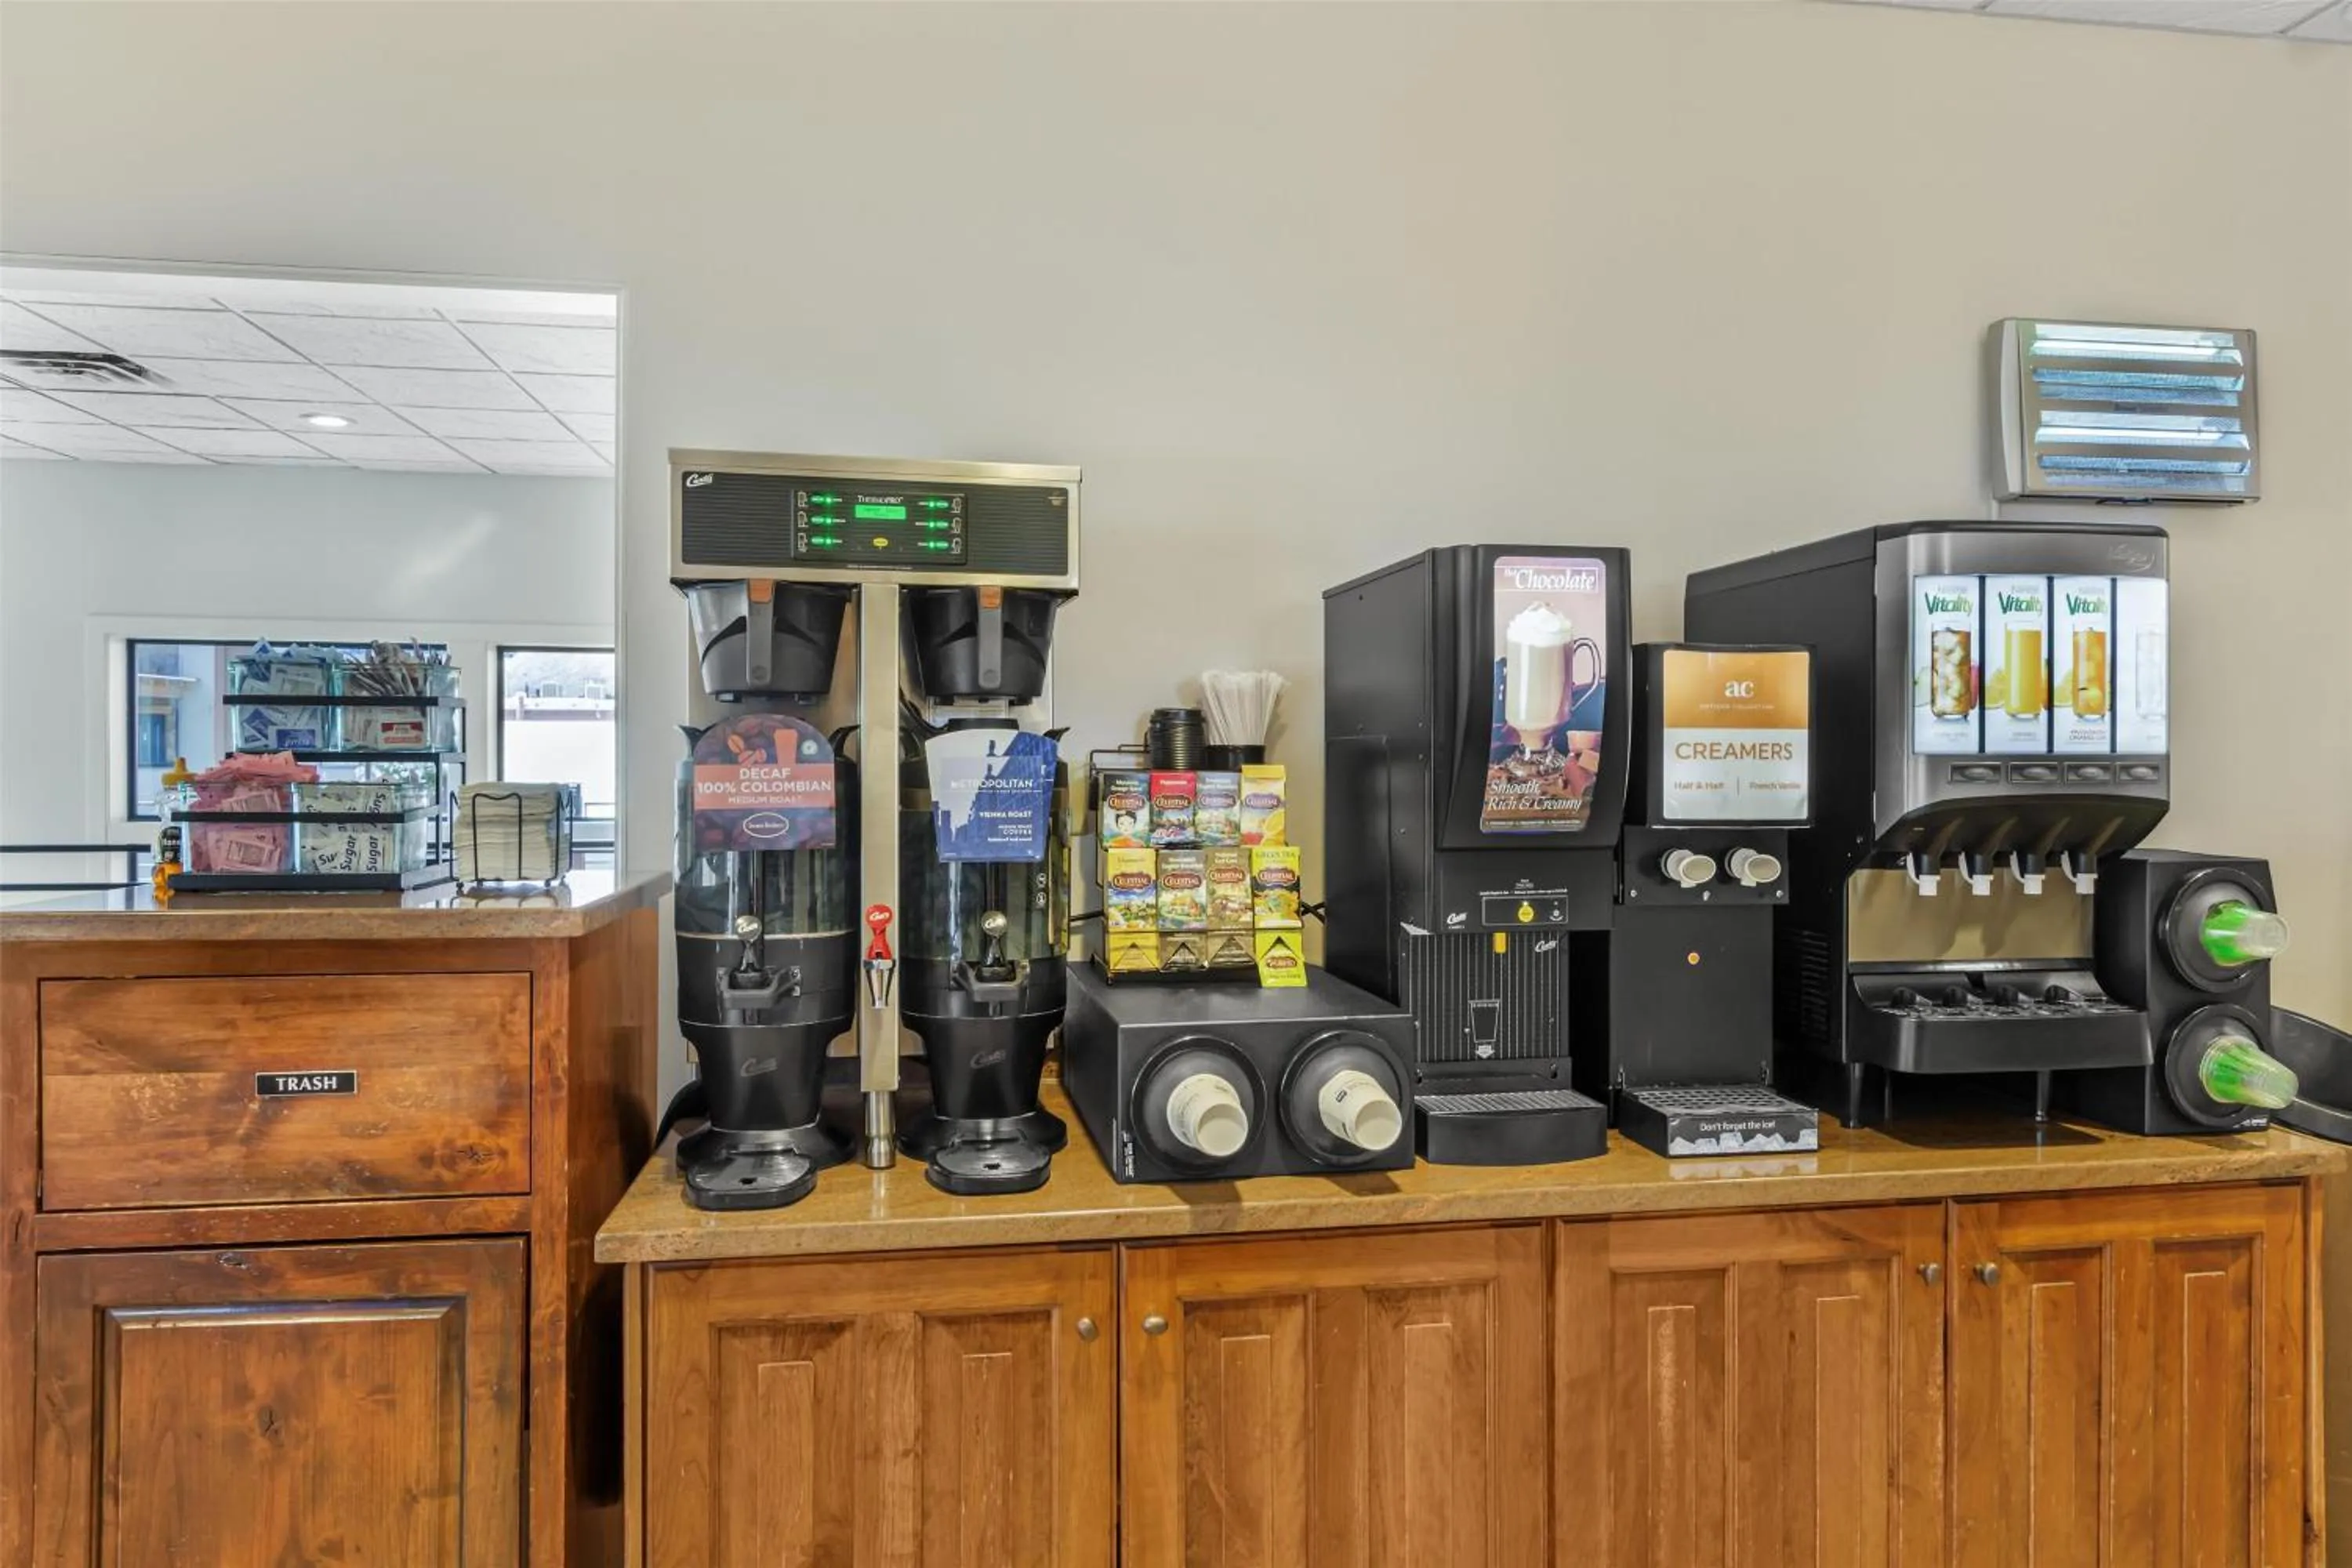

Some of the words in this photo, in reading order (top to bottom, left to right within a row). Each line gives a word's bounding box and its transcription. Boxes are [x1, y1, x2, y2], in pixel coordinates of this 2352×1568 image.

[1515, 569, 1595, 590] Chocolate
[1925, 592, 1973, 617] Vitality
[1998, 591, 2043, 616] Vitality
[1725, 681, 1755, 698] ac
[1675, 742, 1794, 760] CREAMERS
[739, 768, 791, 780] DECAF
[698, 782, 736, 793] 100%
[740, 781, 832, 793] COLOMBIAN
[1487, 797, 1517, 811] Rich
[1519, 797, 1531, 808] &
[1534, 797, 1582, 812] Creamy
[340, 834, 357, 871] Sugar
[366, 835, 381, 872] Sugar
[275, 1076, 337, 1091] TRASH
